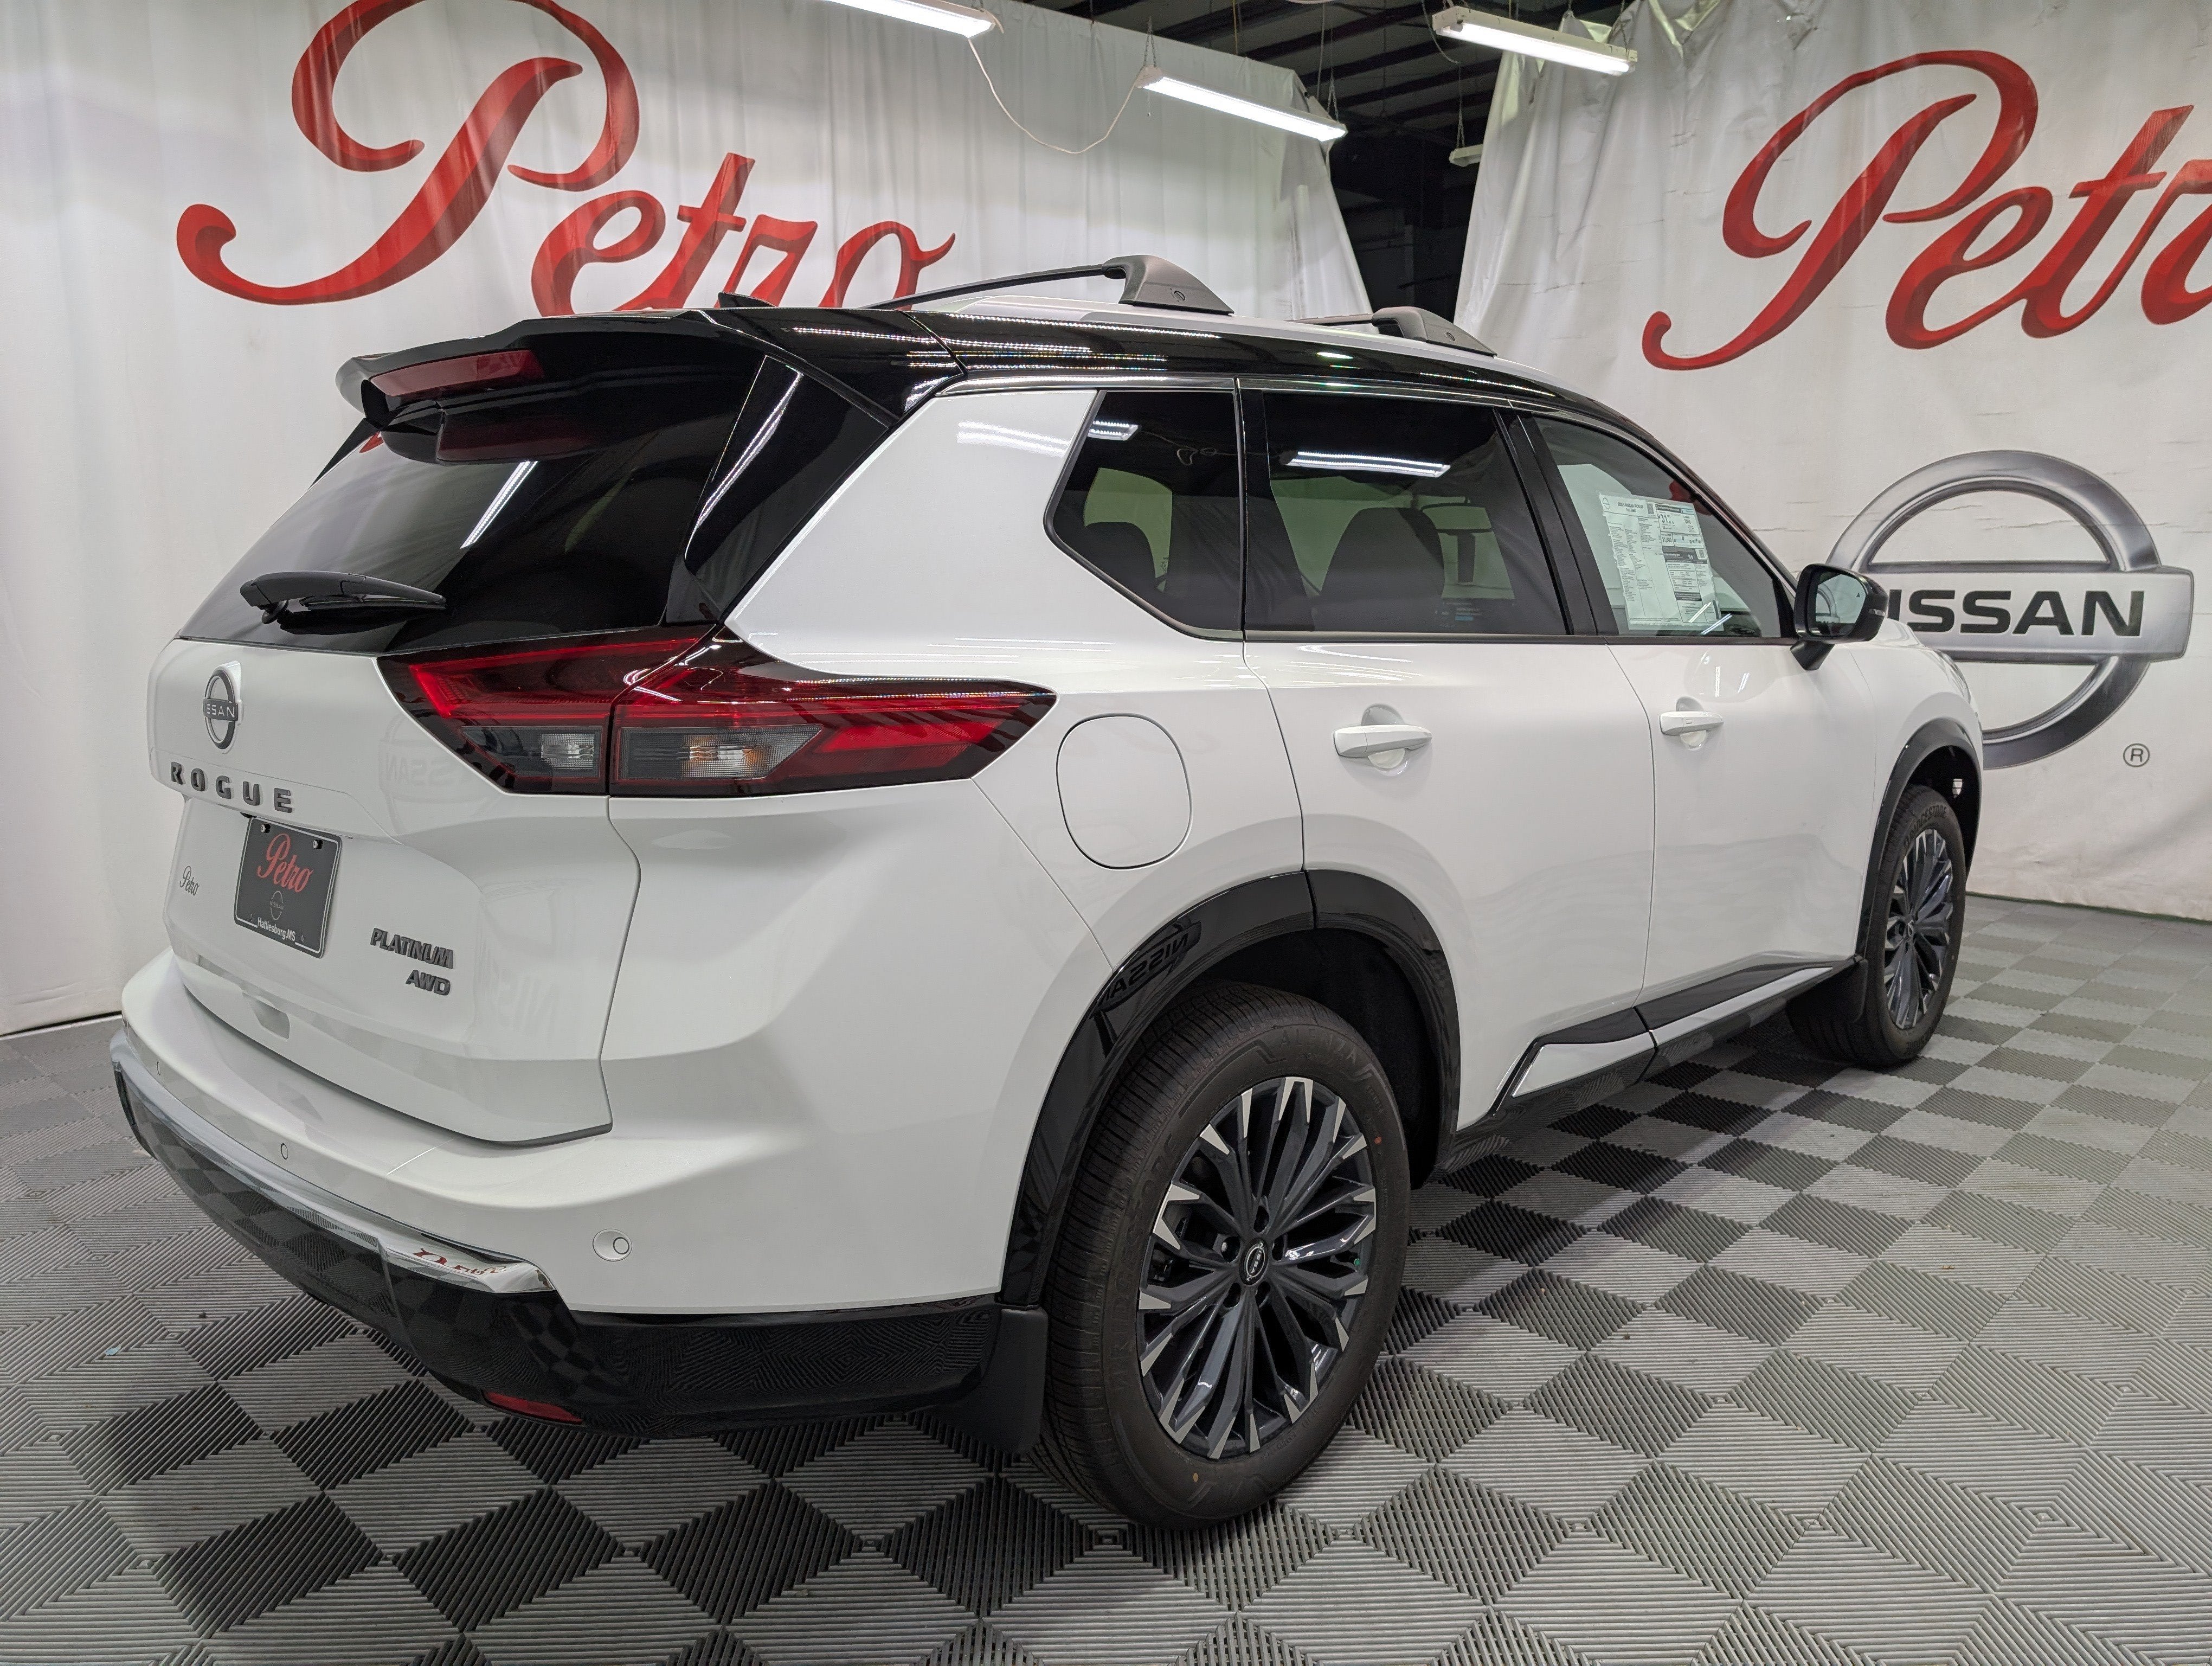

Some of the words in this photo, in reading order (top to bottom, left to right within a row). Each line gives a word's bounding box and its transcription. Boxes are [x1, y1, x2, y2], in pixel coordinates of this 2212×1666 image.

[177, 0, 955, 316] Petro
[1642, 50, 2212, 370] Petr
[1888, 589, 2145, 637] ISSAN
[206, 703, 235, 718] SSAN
[171, 761, 292, 813] ROGUE
[179, 866, 200, 896] Petro
[257, 833, 314, 893] Petro
[370, 927, 453, 969] PLATINUM
[405, 969, 451, 995] AWD
